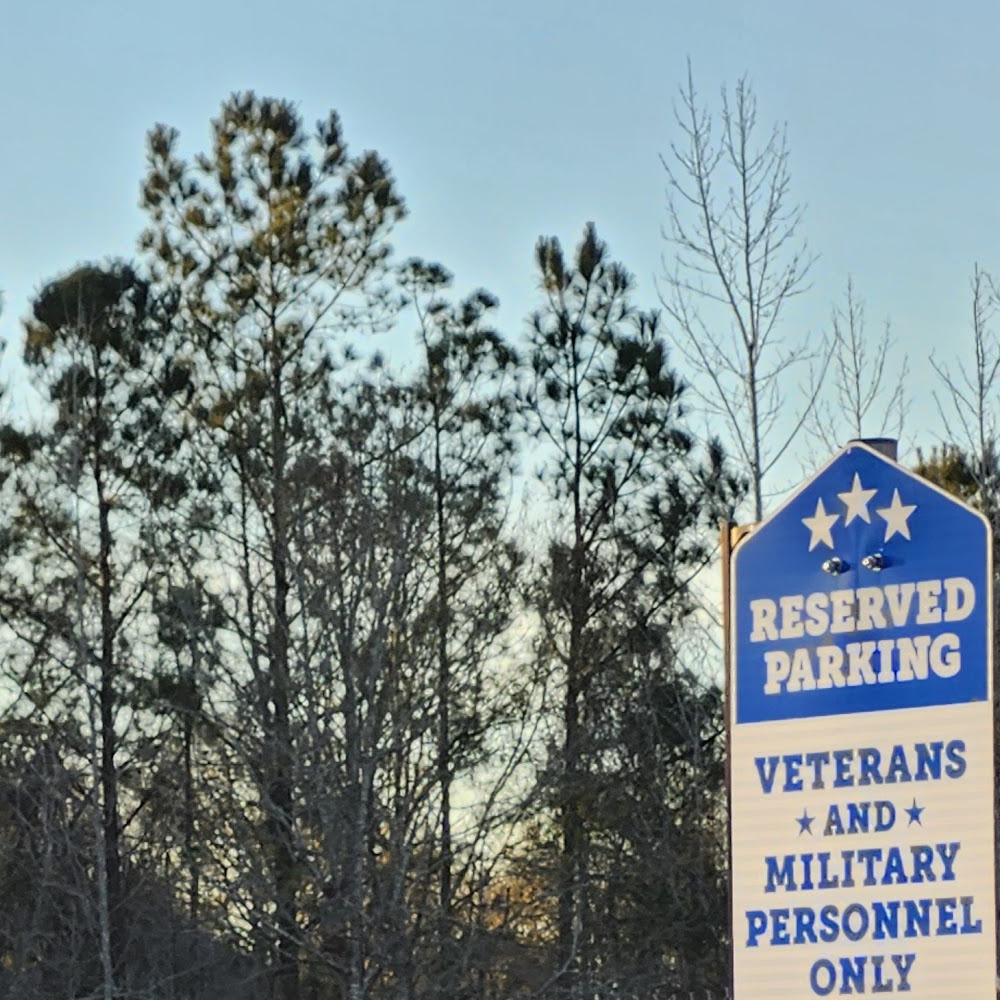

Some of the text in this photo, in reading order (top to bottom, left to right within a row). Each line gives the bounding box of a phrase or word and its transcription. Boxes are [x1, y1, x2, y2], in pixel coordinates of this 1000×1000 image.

[750, 577, 976, 642] RESERVED
[764, 633, 962, 695] PARKING
[754, 740, 967, 794] VETERANS
[823, 801, 896, 836] AND
[764, 842, 961, 893] MILITARY
[745, 896, 982, 948] PERSONNEL
[810, 953, 915, 996] ONLY
